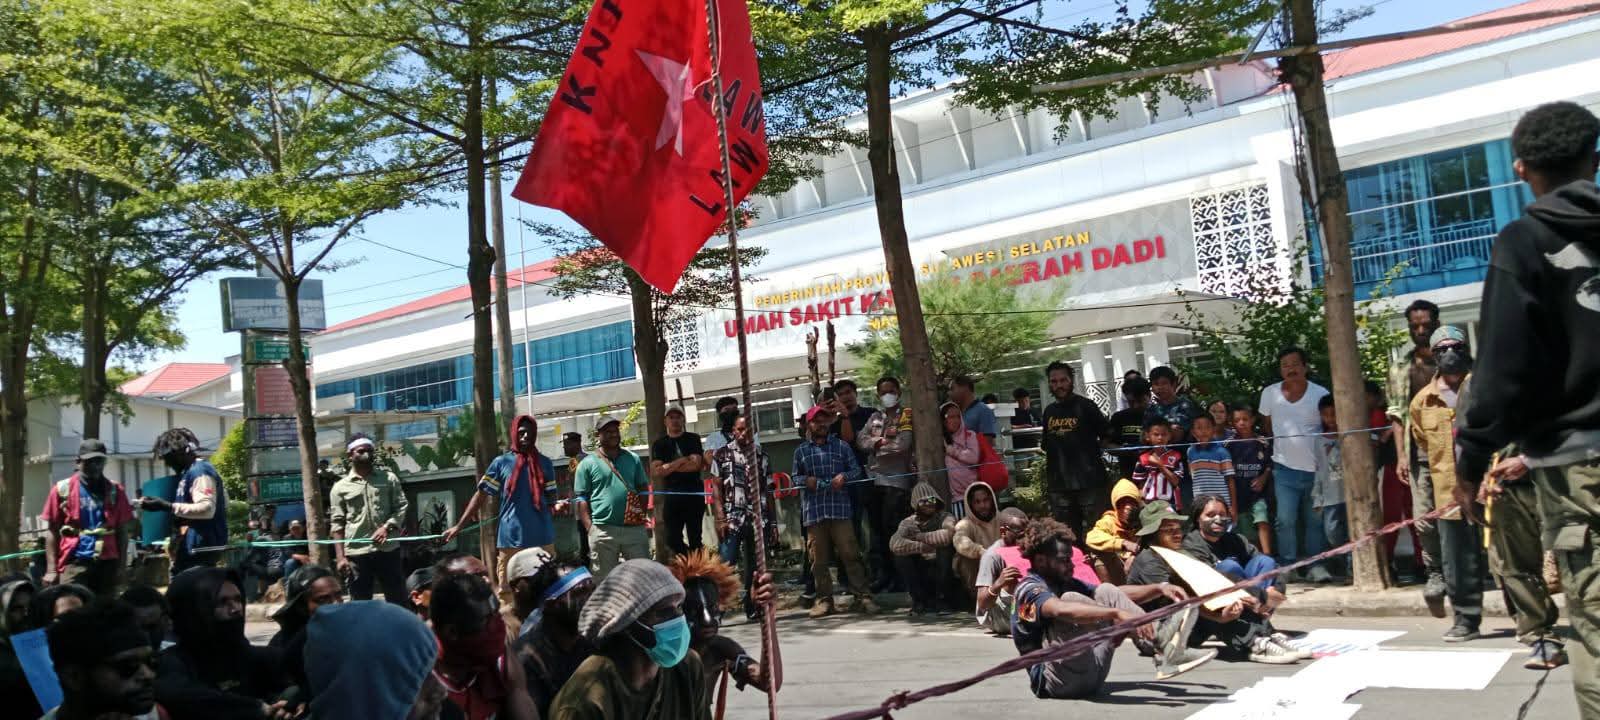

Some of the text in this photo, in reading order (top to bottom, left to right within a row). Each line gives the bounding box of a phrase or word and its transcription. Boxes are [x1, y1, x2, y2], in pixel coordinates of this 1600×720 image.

[724, 311, 784, 338] UMAH
[789, 296, 855, 326] SAKIT
[1091, 235, 1166, 271] DADI
[754, 282, 843, 307] PEMERINTAH
[845, 271, 890, 289] PROVI
[919, 247, 1004, 276] SUAWESI
[1010, 231, 1090, 259] SELATAN
